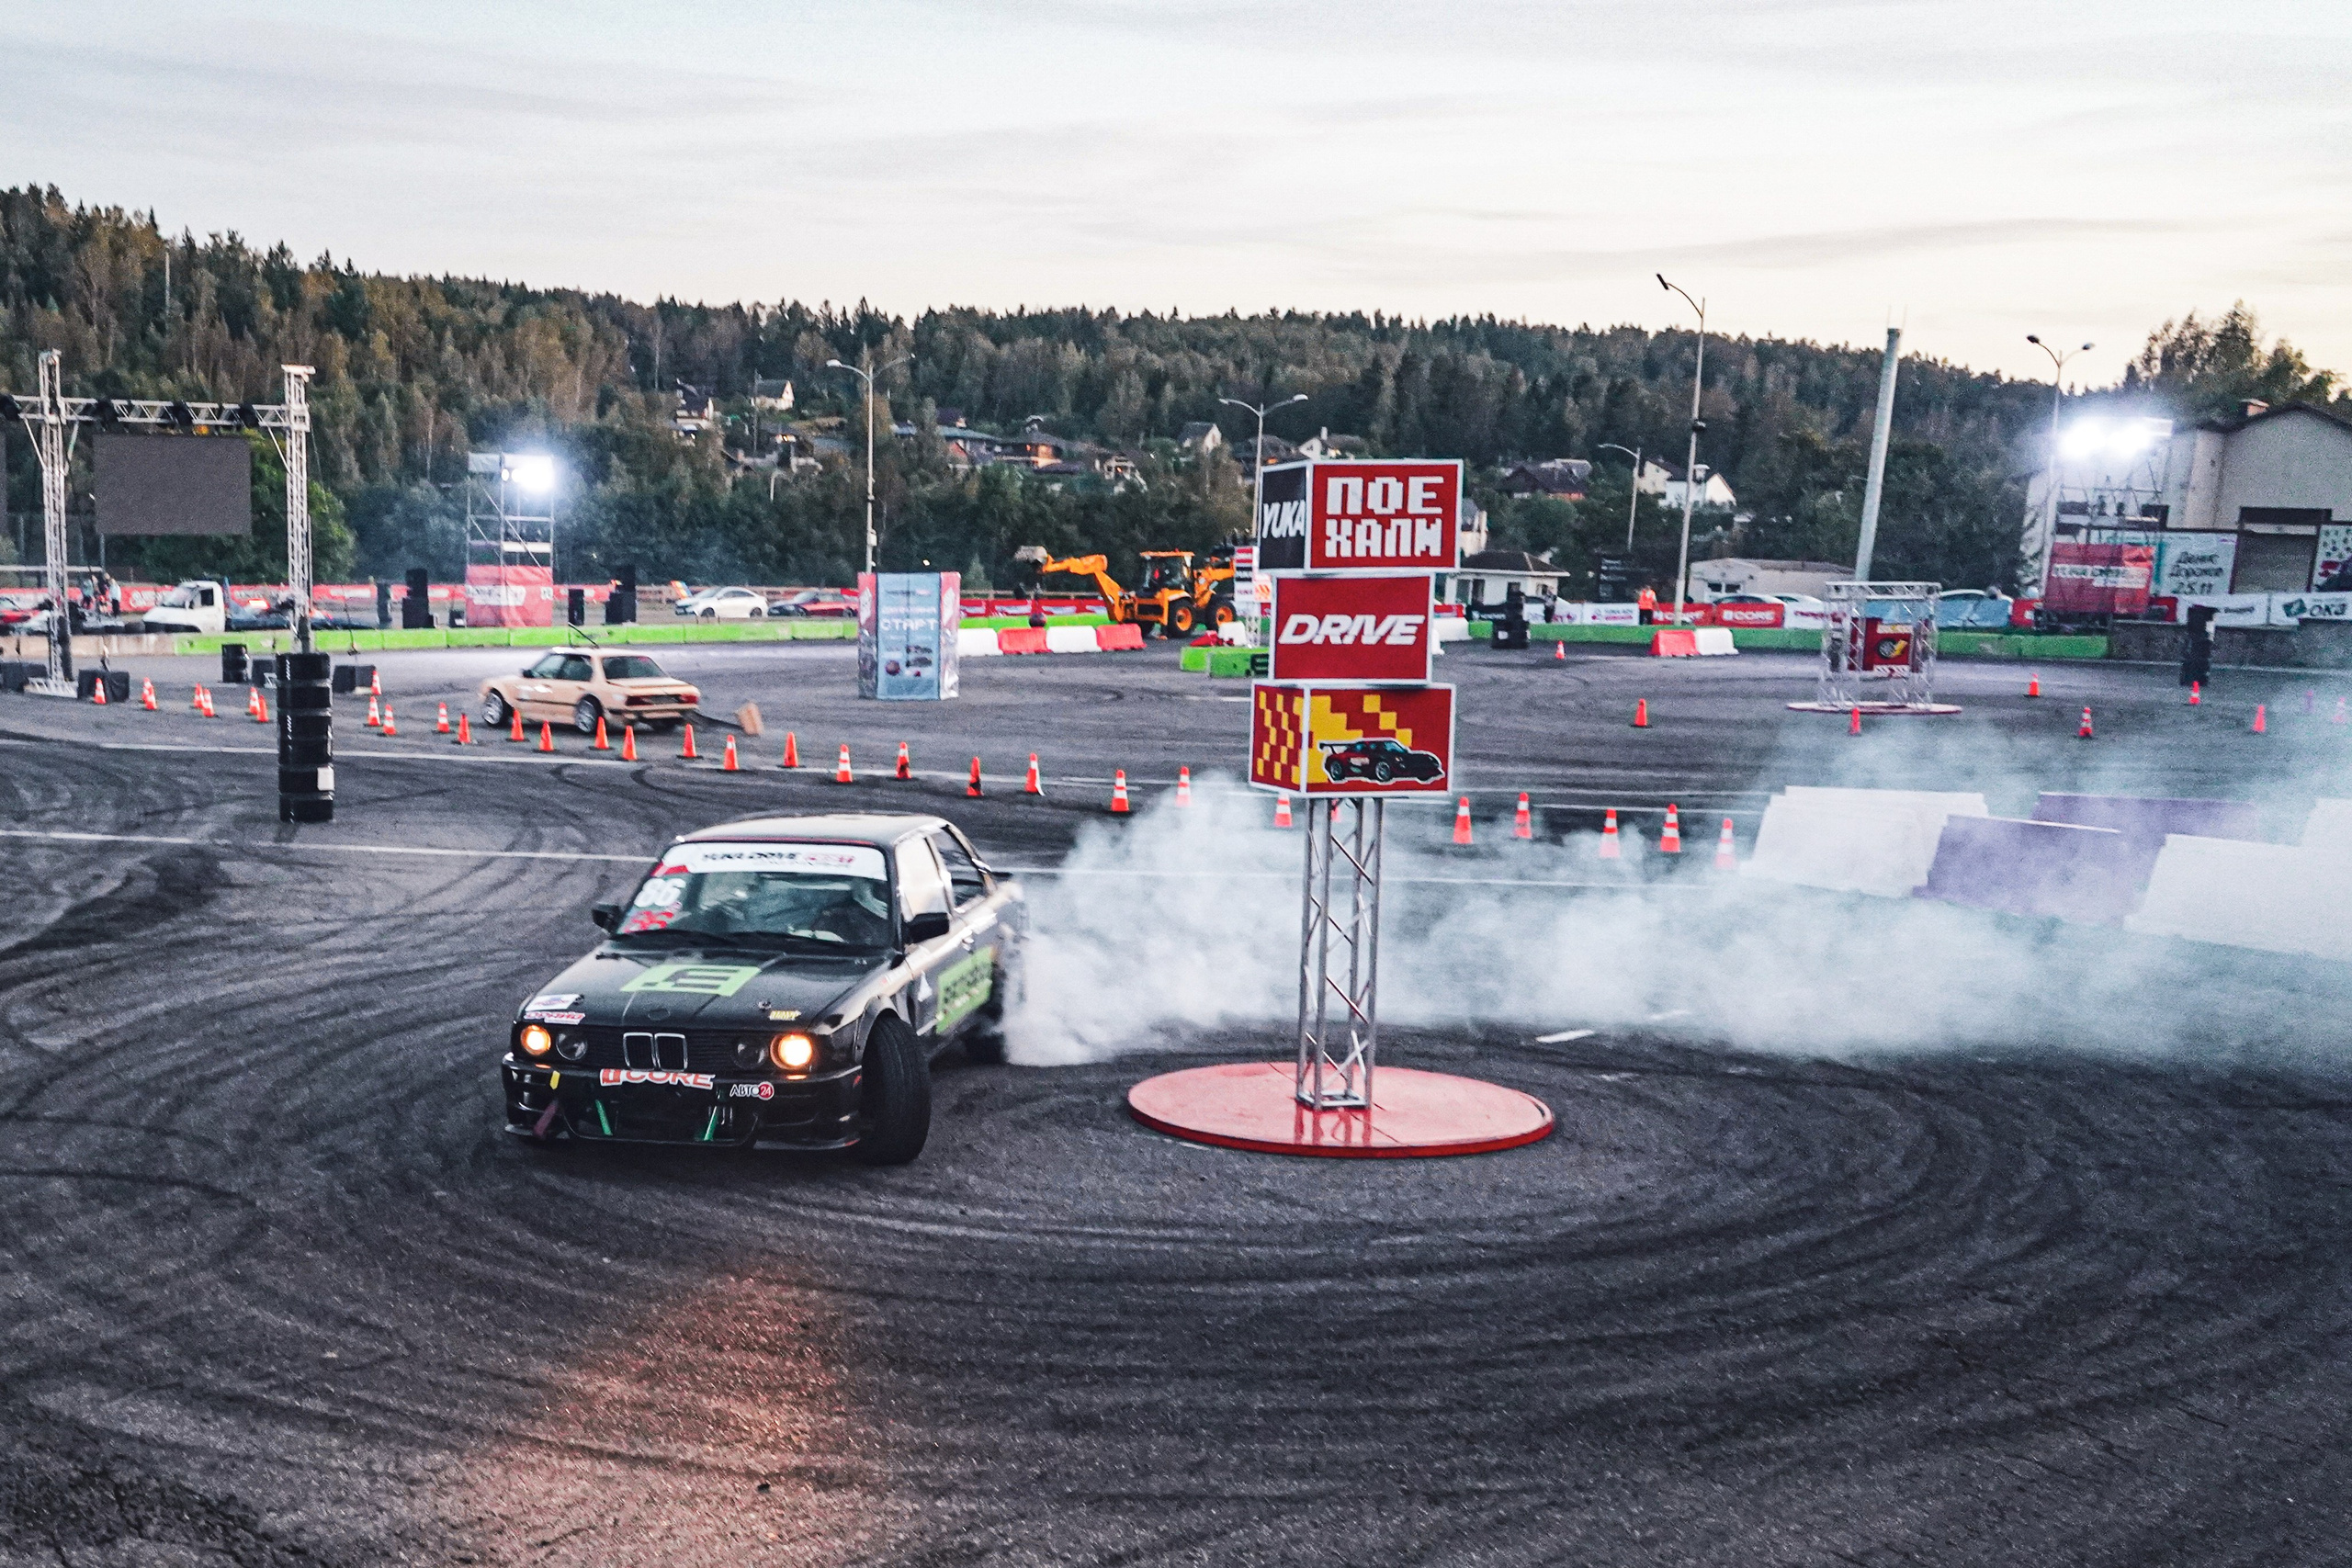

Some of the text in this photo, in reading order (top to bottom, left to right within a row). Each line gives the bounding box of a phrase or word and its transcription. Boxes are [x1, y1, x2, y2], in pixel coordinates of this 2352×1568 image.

[1262, 499, 1306, 538] YUKA
[1278, 614, 1426, 645] DRIVE
[634, 878, 686, 908] 86
